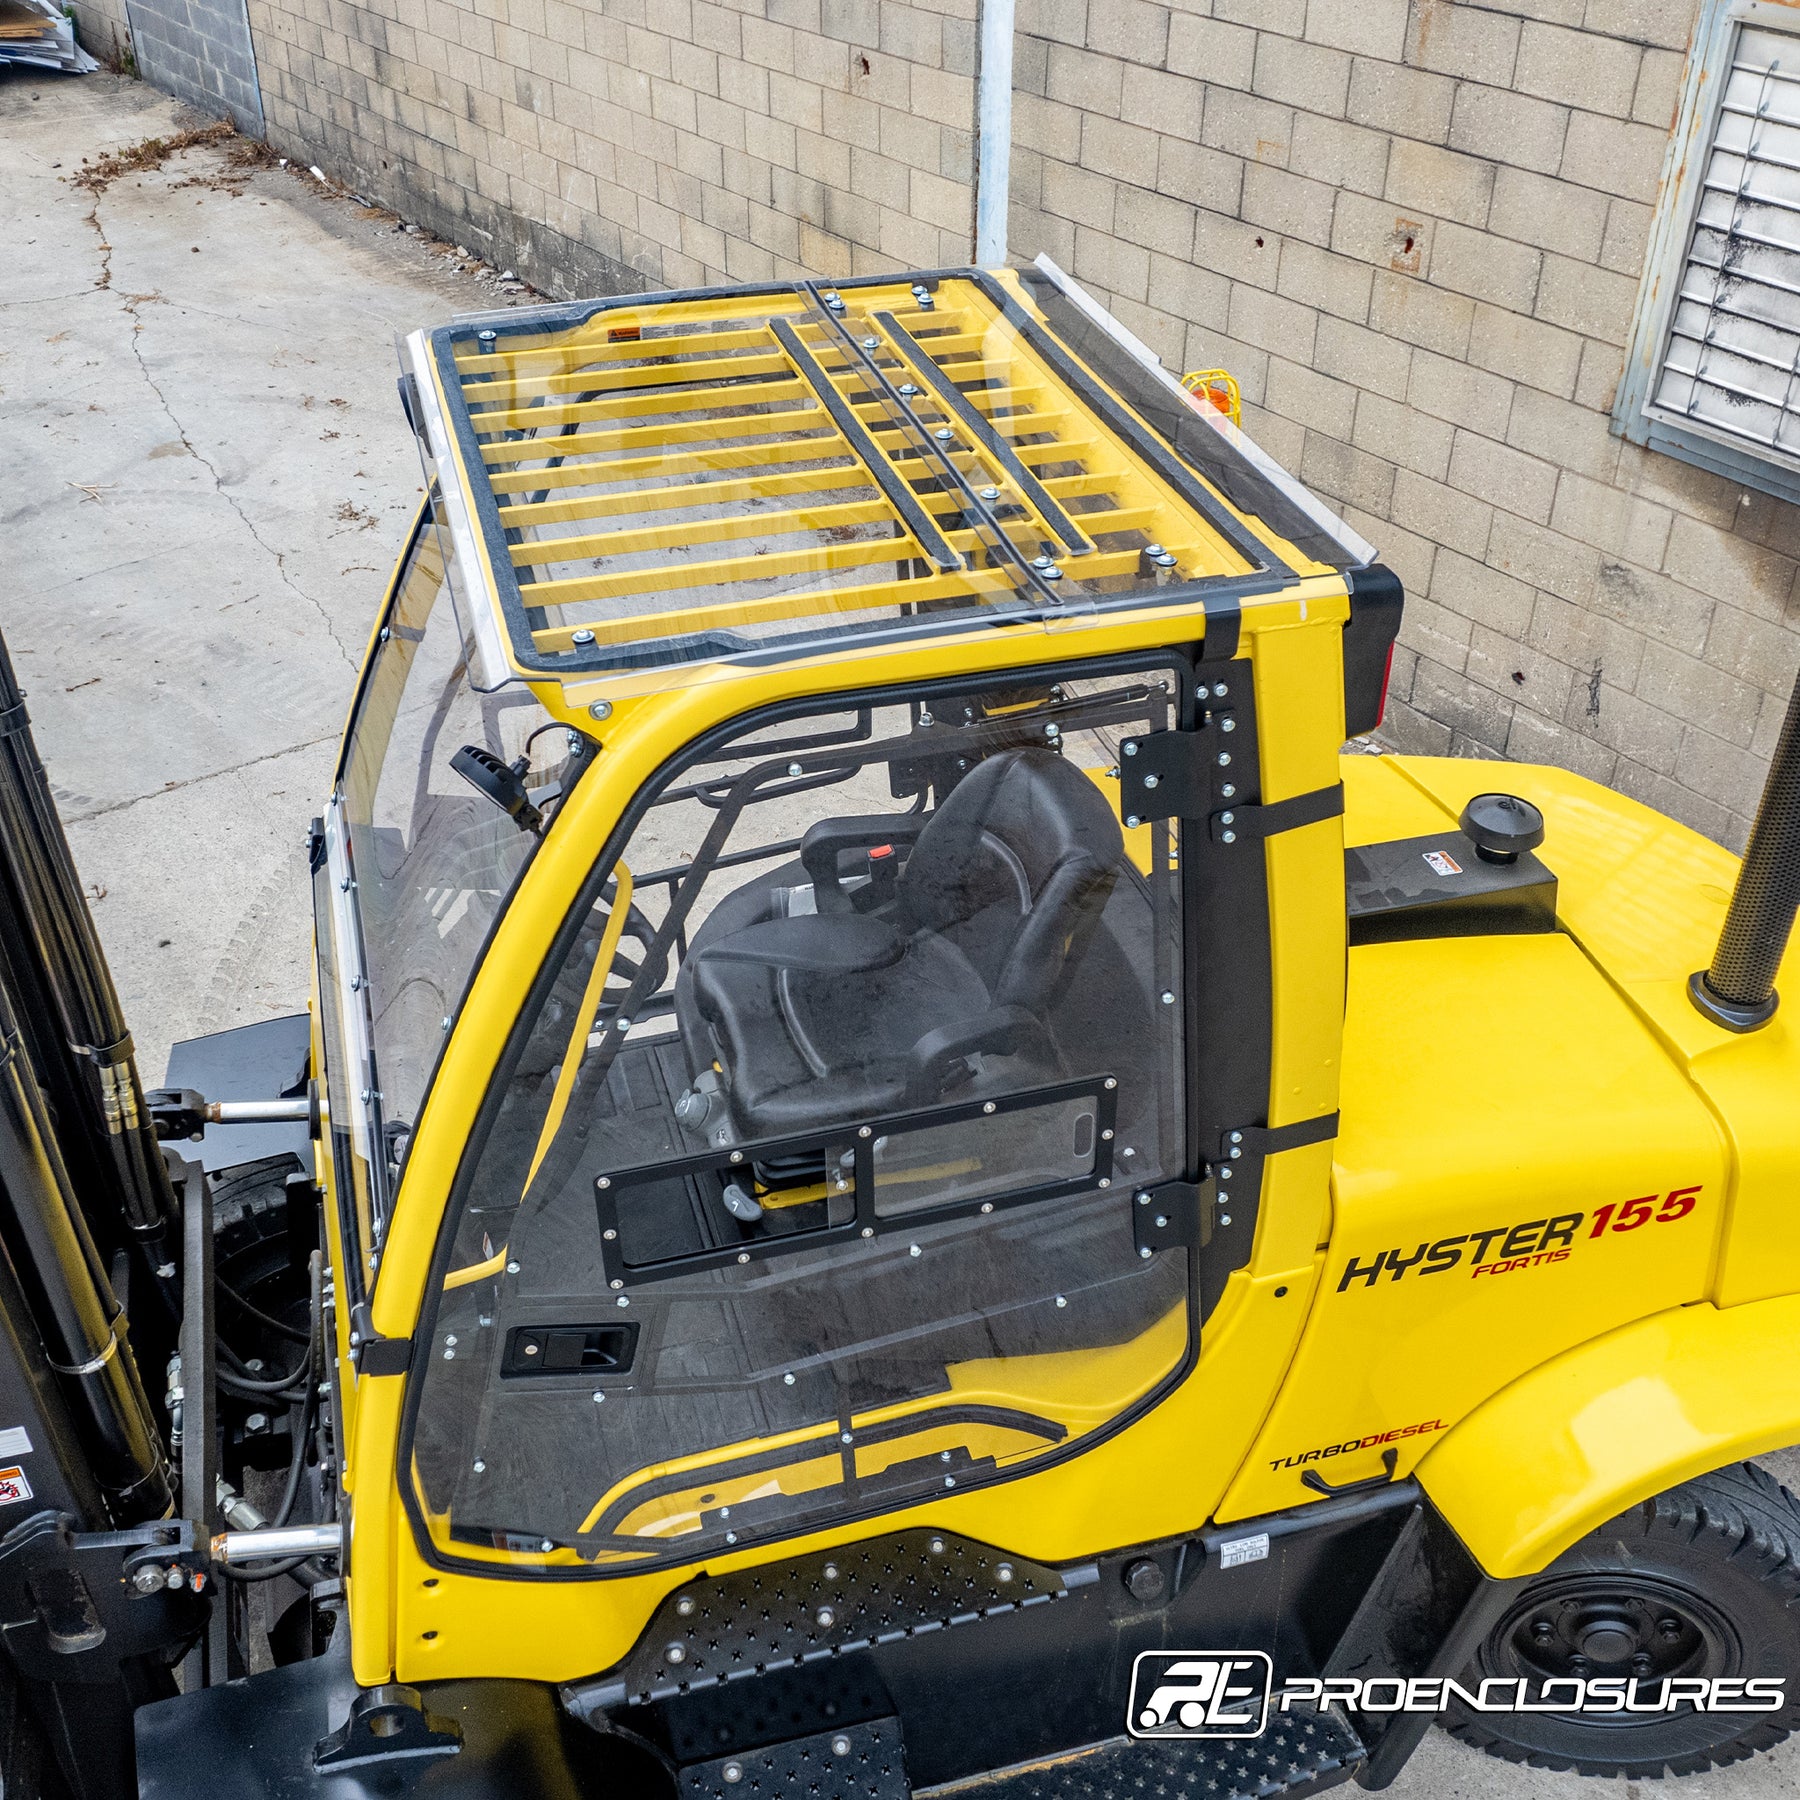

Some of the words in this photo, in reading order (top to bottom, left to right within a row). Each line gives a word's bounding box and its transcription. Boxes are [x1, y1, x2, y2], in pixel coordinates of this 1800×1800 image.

[1336, 1212, 1585, 1293] HYSTER
[1589, 1185, 1703, 1239] 155
[1471, 1248, 1572, 1279] FORTIS
[1269, 1419, 1449, 1472] TURBODIESEL
